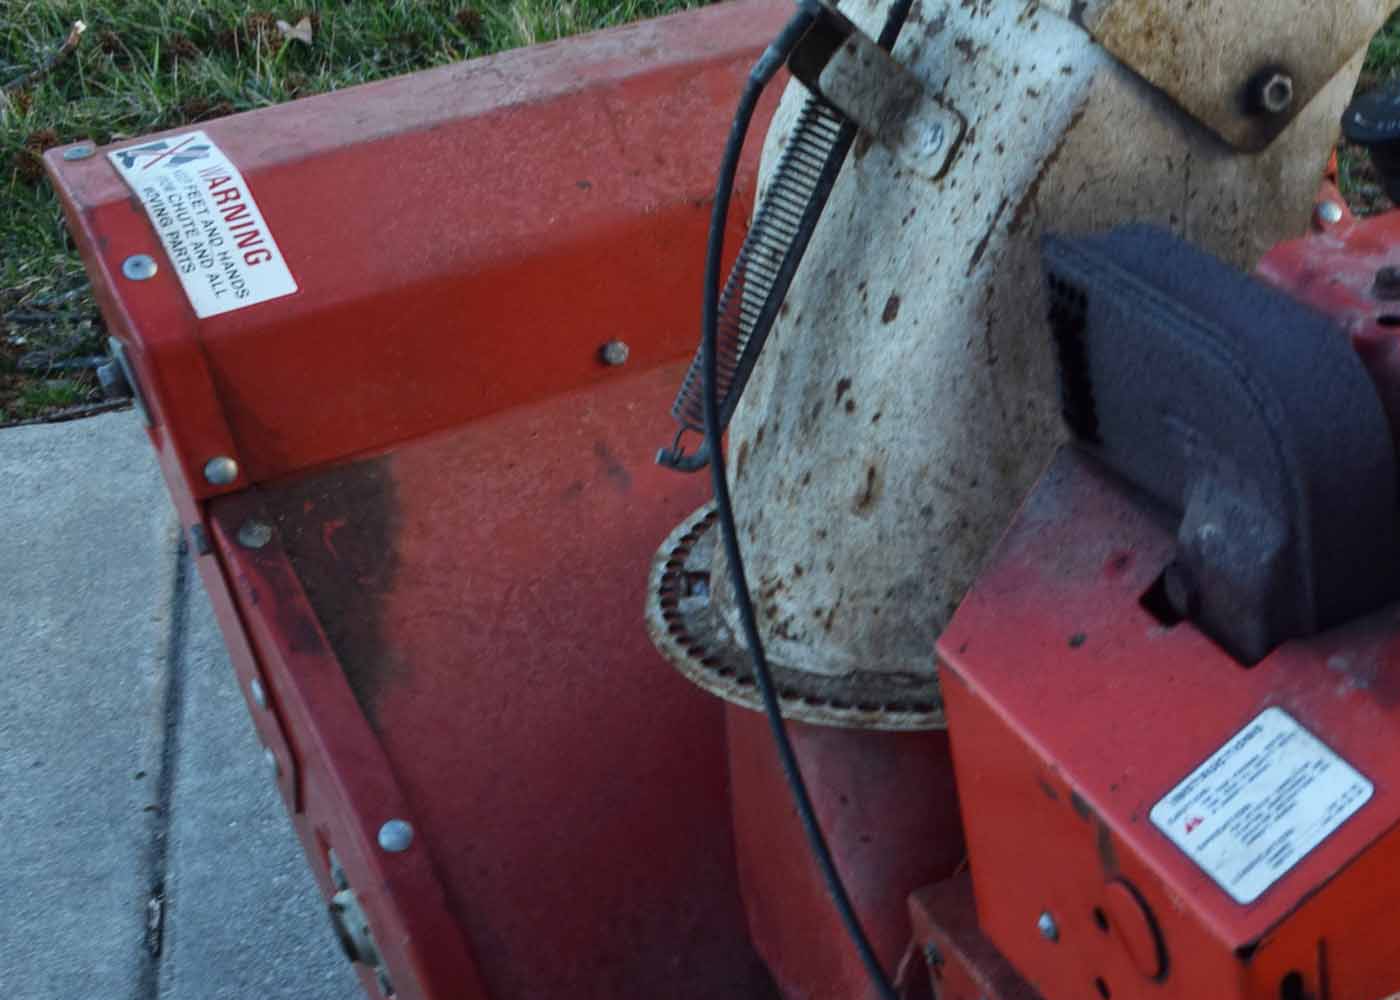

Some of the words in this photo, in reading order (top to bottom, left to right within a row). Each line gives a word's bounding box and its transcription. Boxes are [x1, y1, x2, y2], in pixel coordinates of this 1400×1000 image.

[165, 230, 196, 274] PARTS
[168, 193, 199, 238] CHUTE
[191, 240, 214, 269] AND
[207, 273, 227, 298] ALL
[200, 219, 224, 247] AND
[217, 250, 250, 299] HANDS
